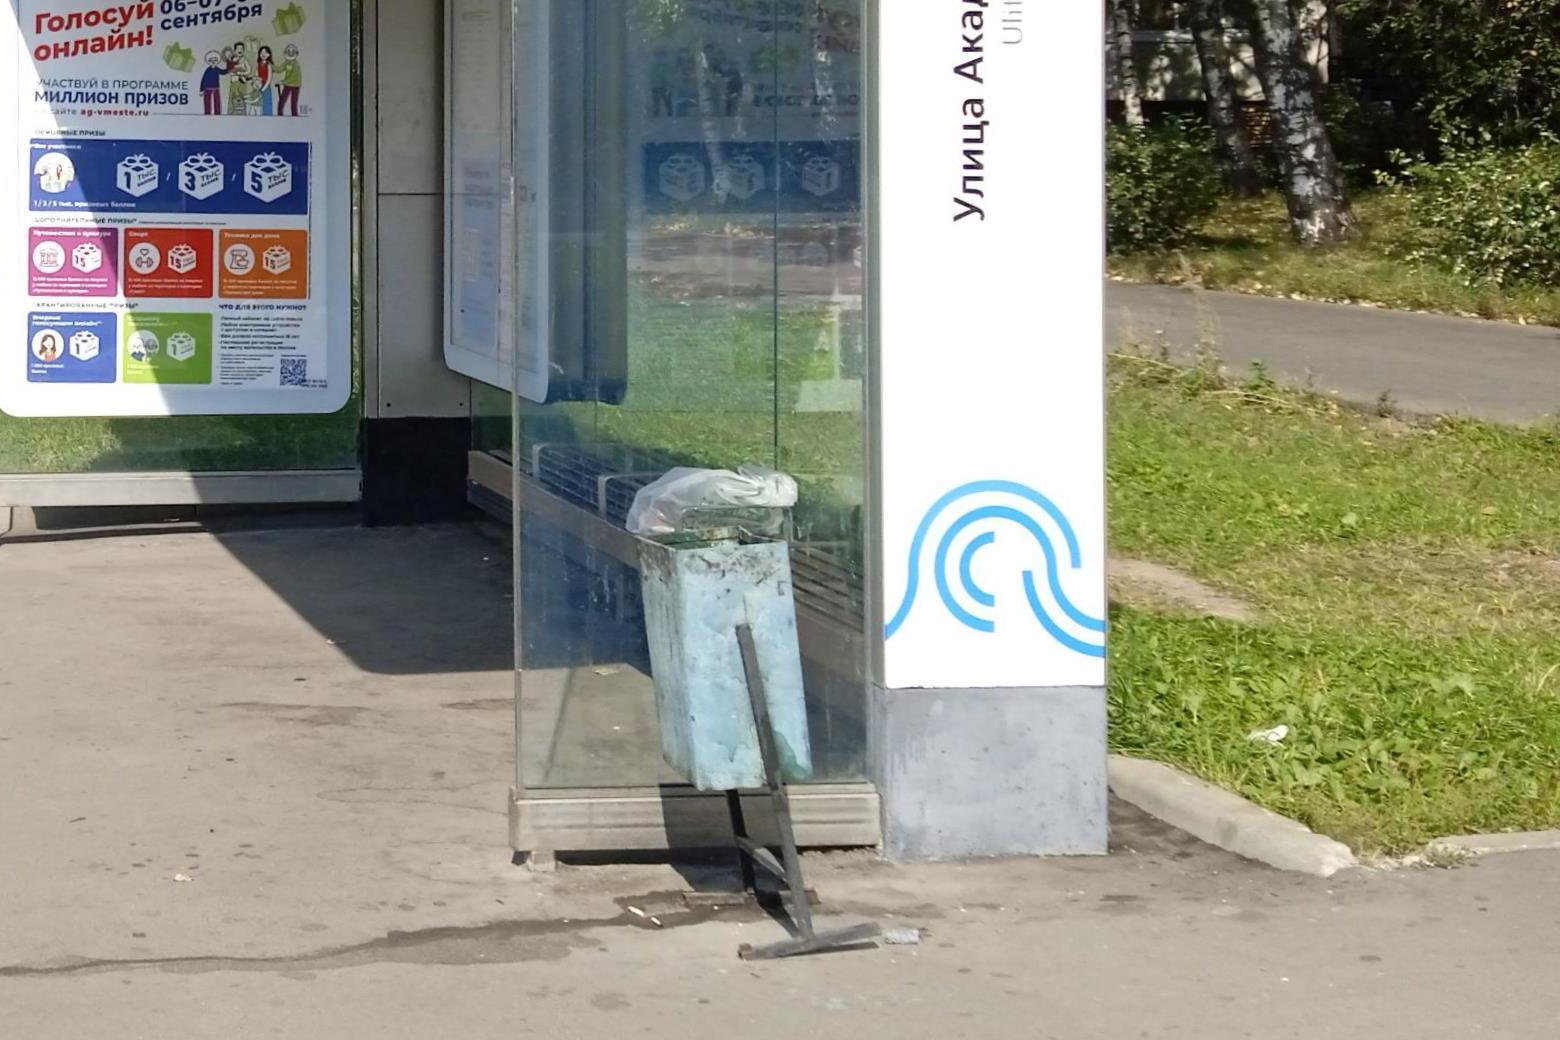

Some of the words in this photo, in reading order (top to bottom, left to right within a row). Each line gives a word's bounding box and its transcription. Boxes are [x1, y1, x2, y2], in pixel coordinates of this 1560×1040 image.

[160, 4, 262, 31] сентября
[34, 25, 153, 61] онлайн!
[37, 77, 98, 89] УЧАСТВУЙ
[101, 80, 109, 89] В
[113, 80, 189, 90] ПРОГРАММЕ
[125, 92, 189, 107] призов
[80, 109, 149, 117] ag-vmeste.ru
[953, 98, 989, 222] Улица
[124, 171, 131, 190] 1
[184, 171, 196, 191] 3
[251, 171, 263, 194] 5
[74, 254, 86, 267] 15
[170, 255, 182, 269] 15
[265, 255, 276, 269] 15
